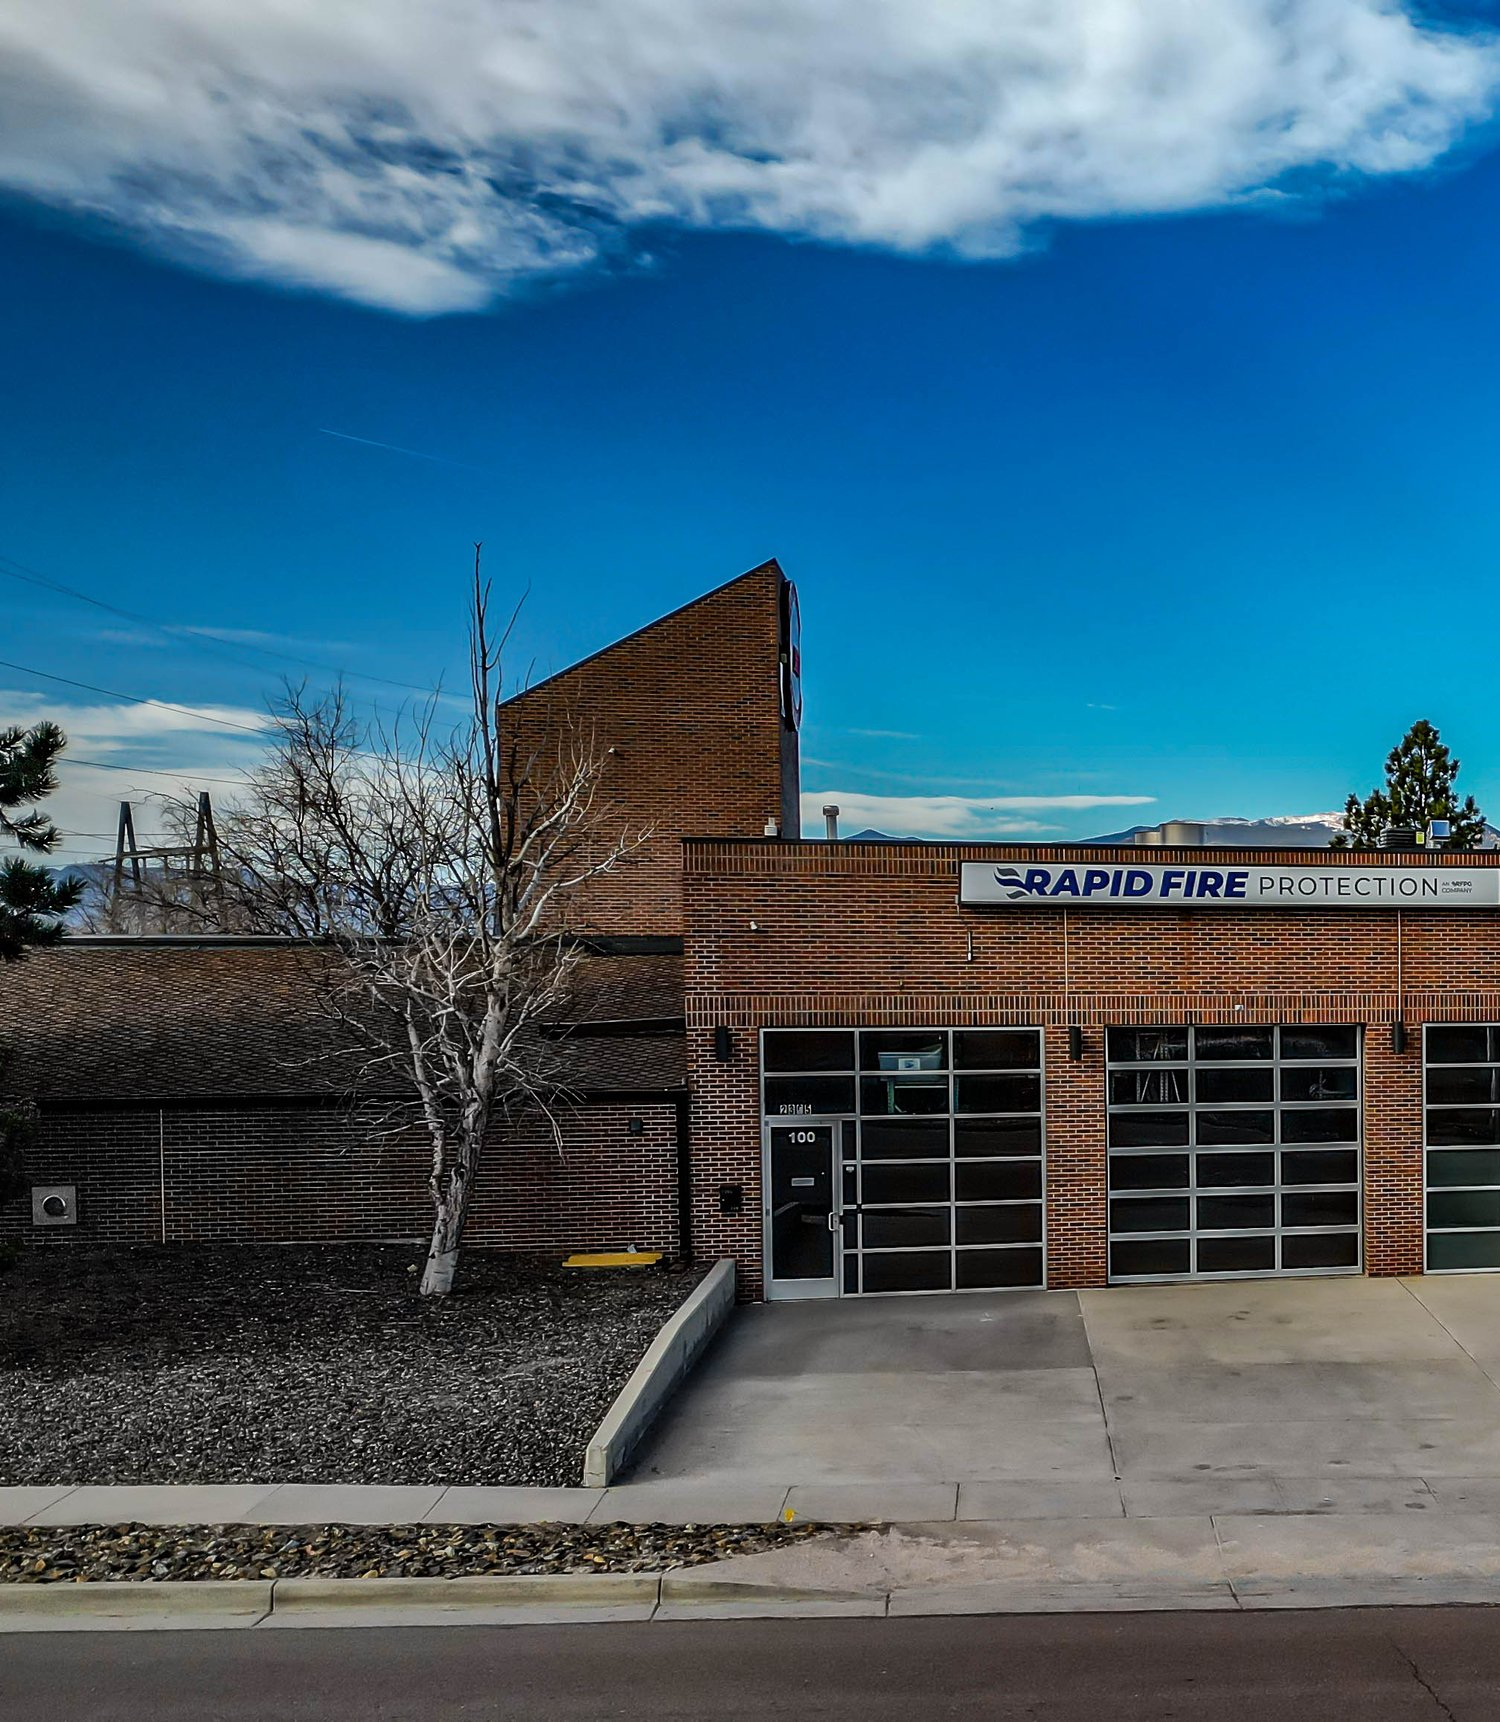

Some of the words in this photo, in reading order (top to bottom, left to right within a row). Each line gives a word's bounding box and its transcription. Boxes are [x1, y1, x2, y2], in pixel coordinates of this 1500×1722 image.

[1023, 868, 1154, 897] RAPID
[1159, 870, 1249, 898] FIRE
[1259, 876, 1438, 896] PROTECTION
[788, 1132, 816, 1143] 100
